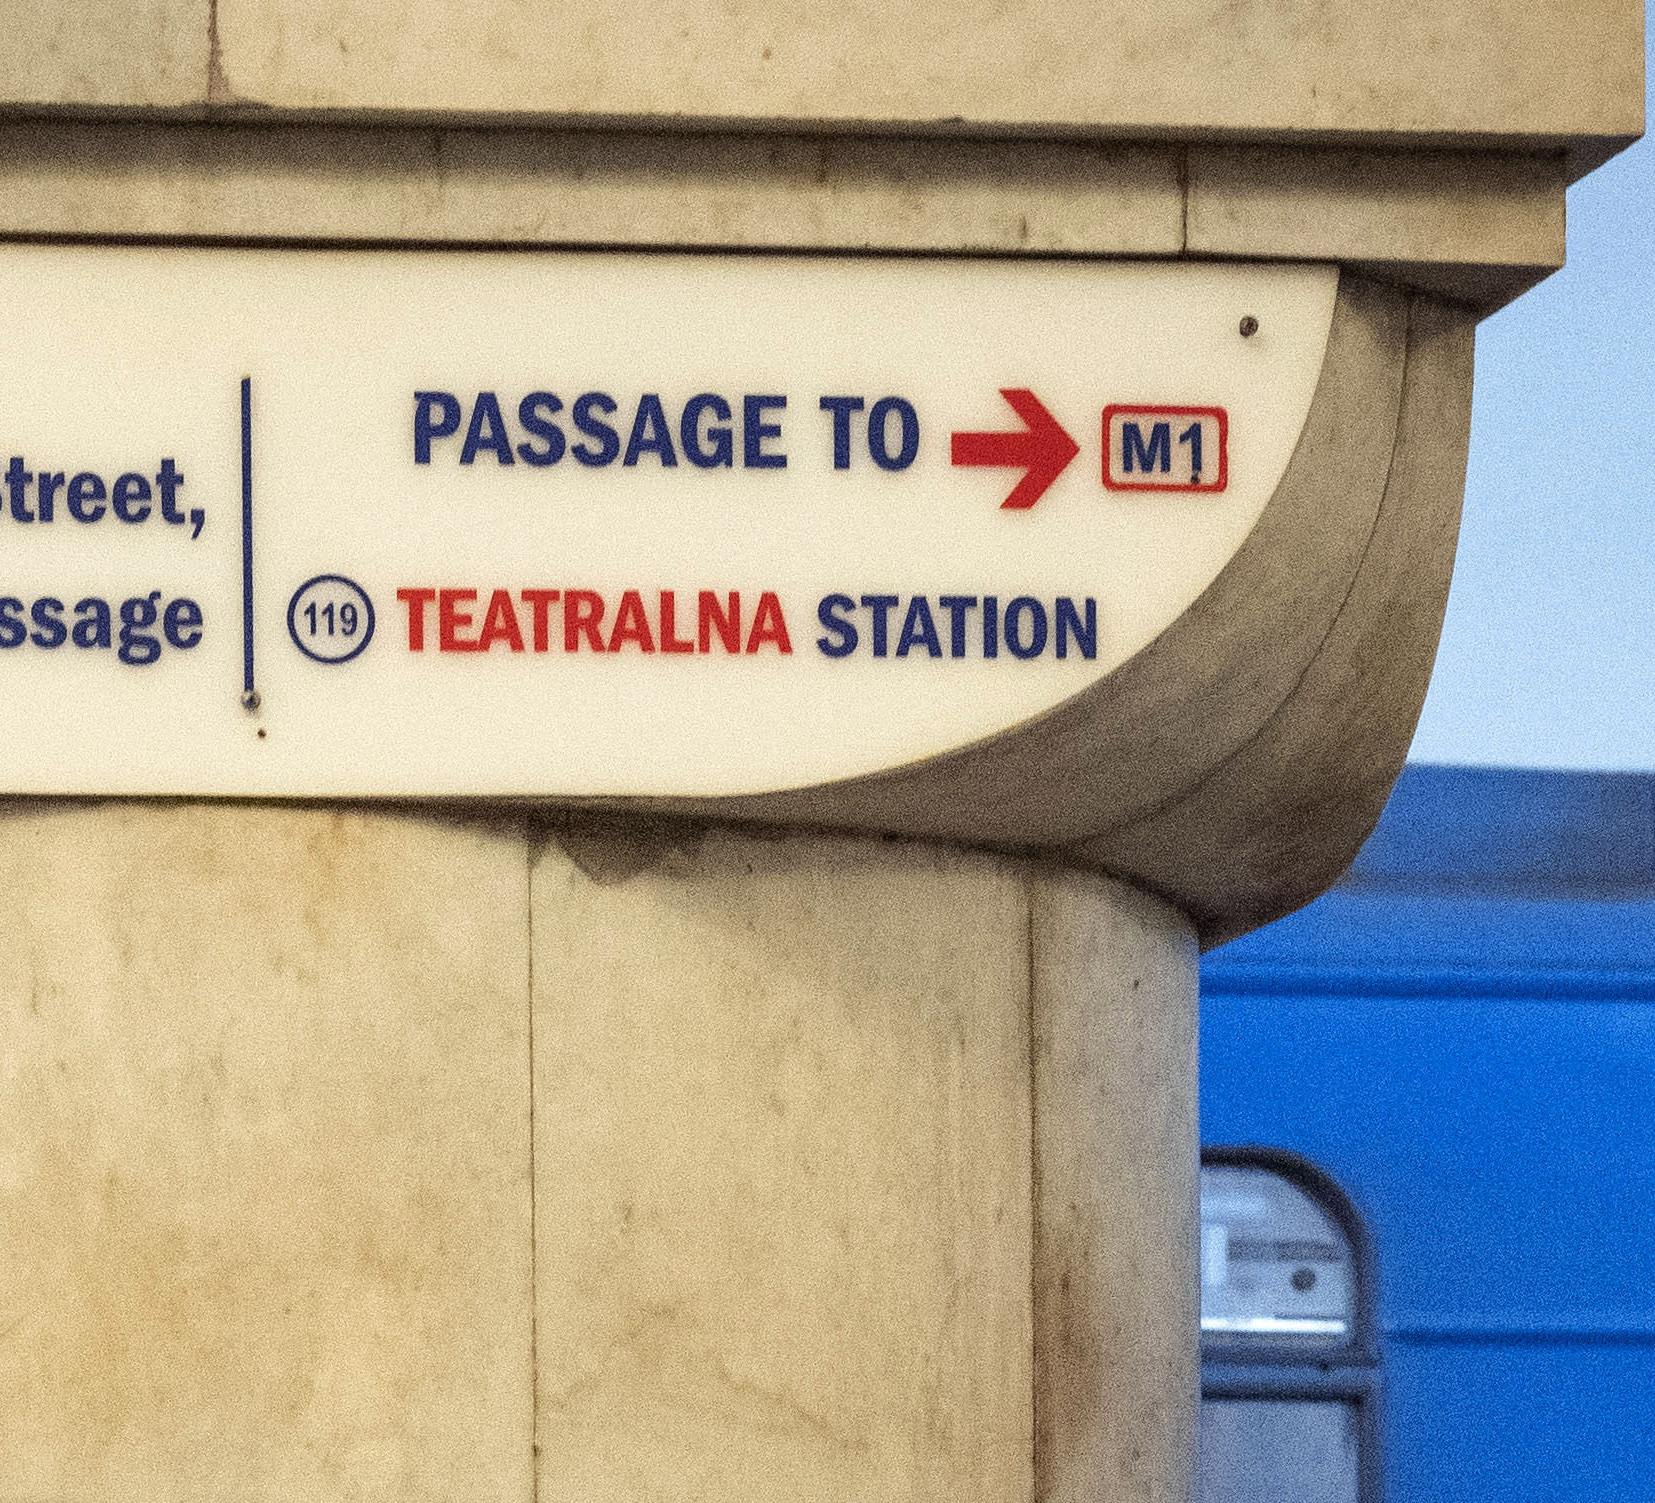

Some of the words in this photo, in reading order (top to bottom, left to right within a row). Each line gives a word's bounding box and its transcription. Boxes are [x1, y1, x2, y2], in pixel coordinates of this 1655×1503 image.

[414, 392, 788, 470] PASSAGE
[820, 396, 921, 472] TO
[1120, 423, 1206, 483] M1
[305, 603, 359, 638] 119
[397, 589, 793, 655] TEATRALNA
[817, 594, 1098, 660] STATION
